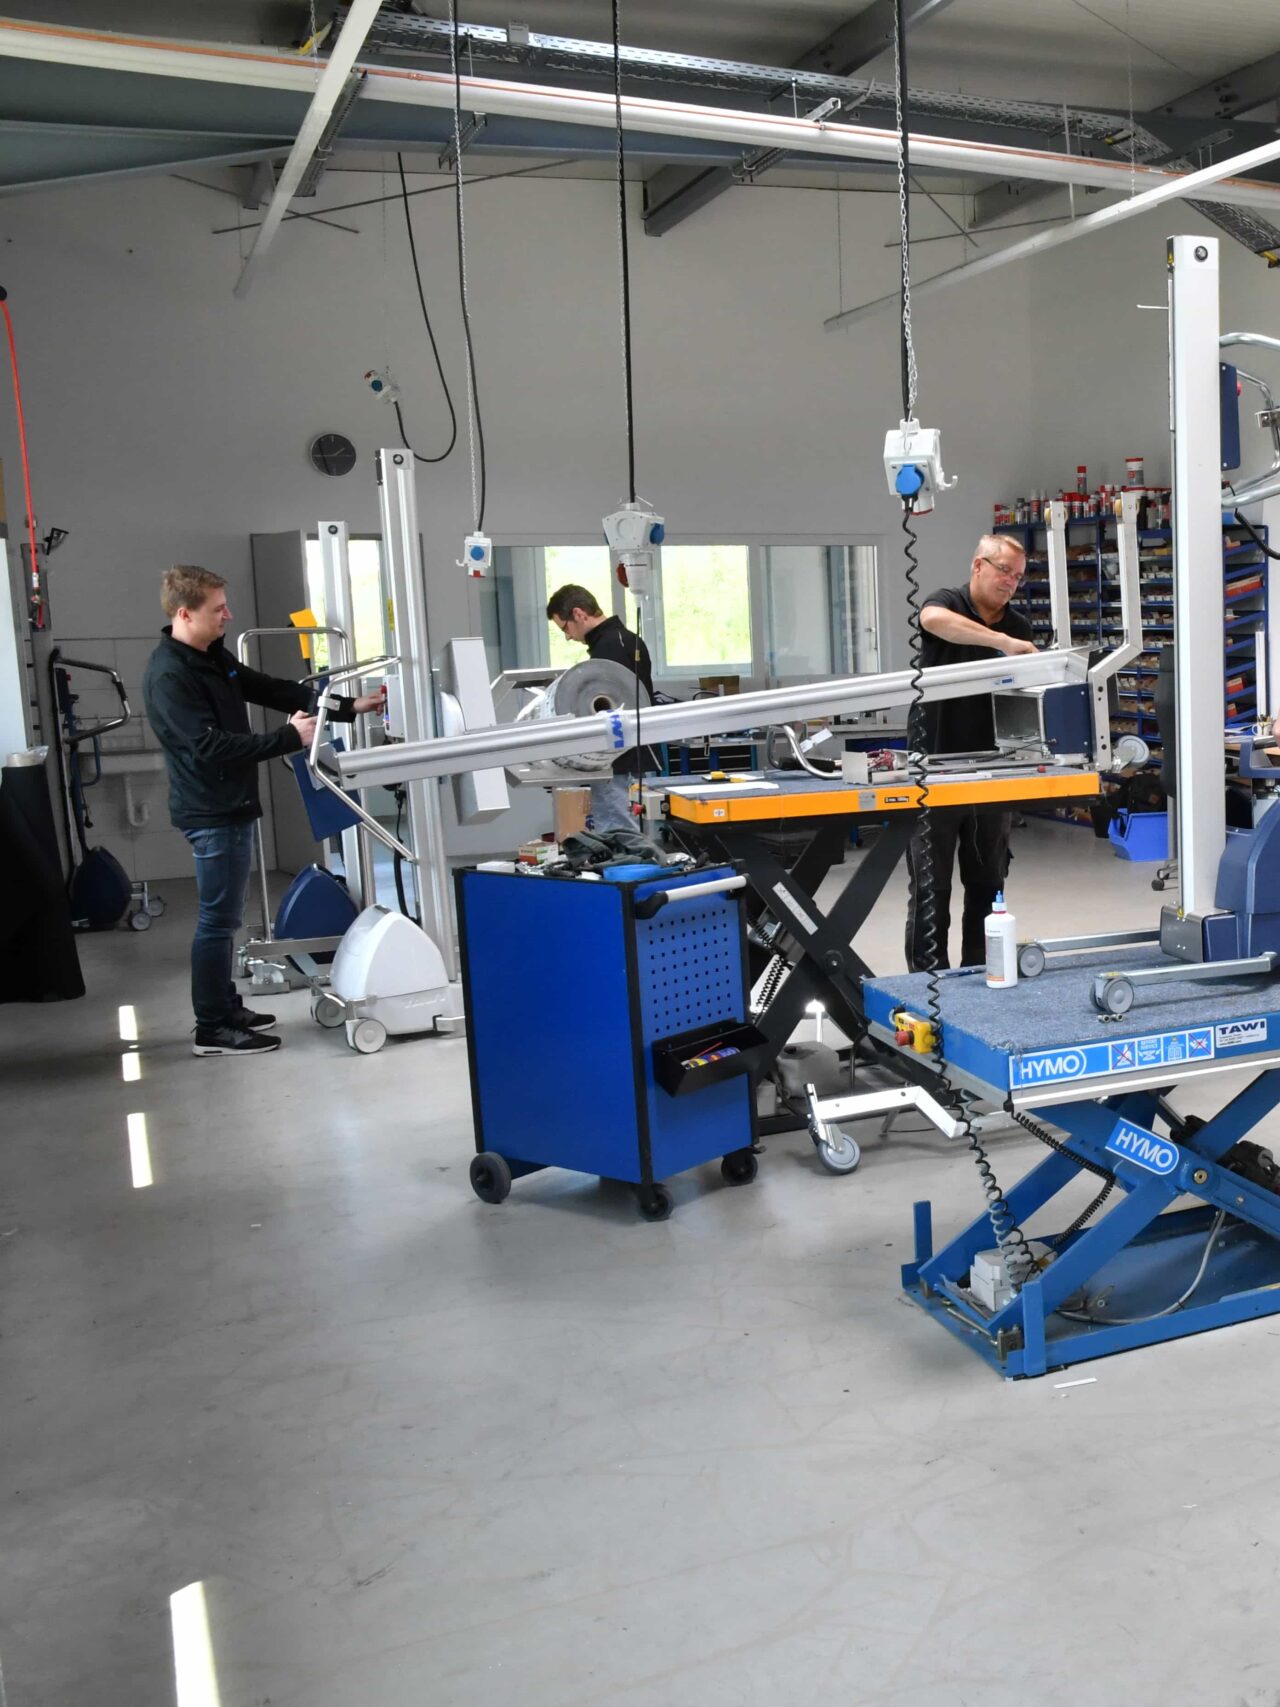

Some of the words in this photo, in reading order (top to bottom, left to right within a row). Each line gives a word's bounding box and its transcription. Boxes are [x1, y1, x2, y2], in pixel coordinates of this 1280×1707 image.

[1219, 1021, 1265, 1035] TAWI
[1021, 1054, 1080, 1080] HYMO
[1115, 1127, 1173, 1168] HYMO
